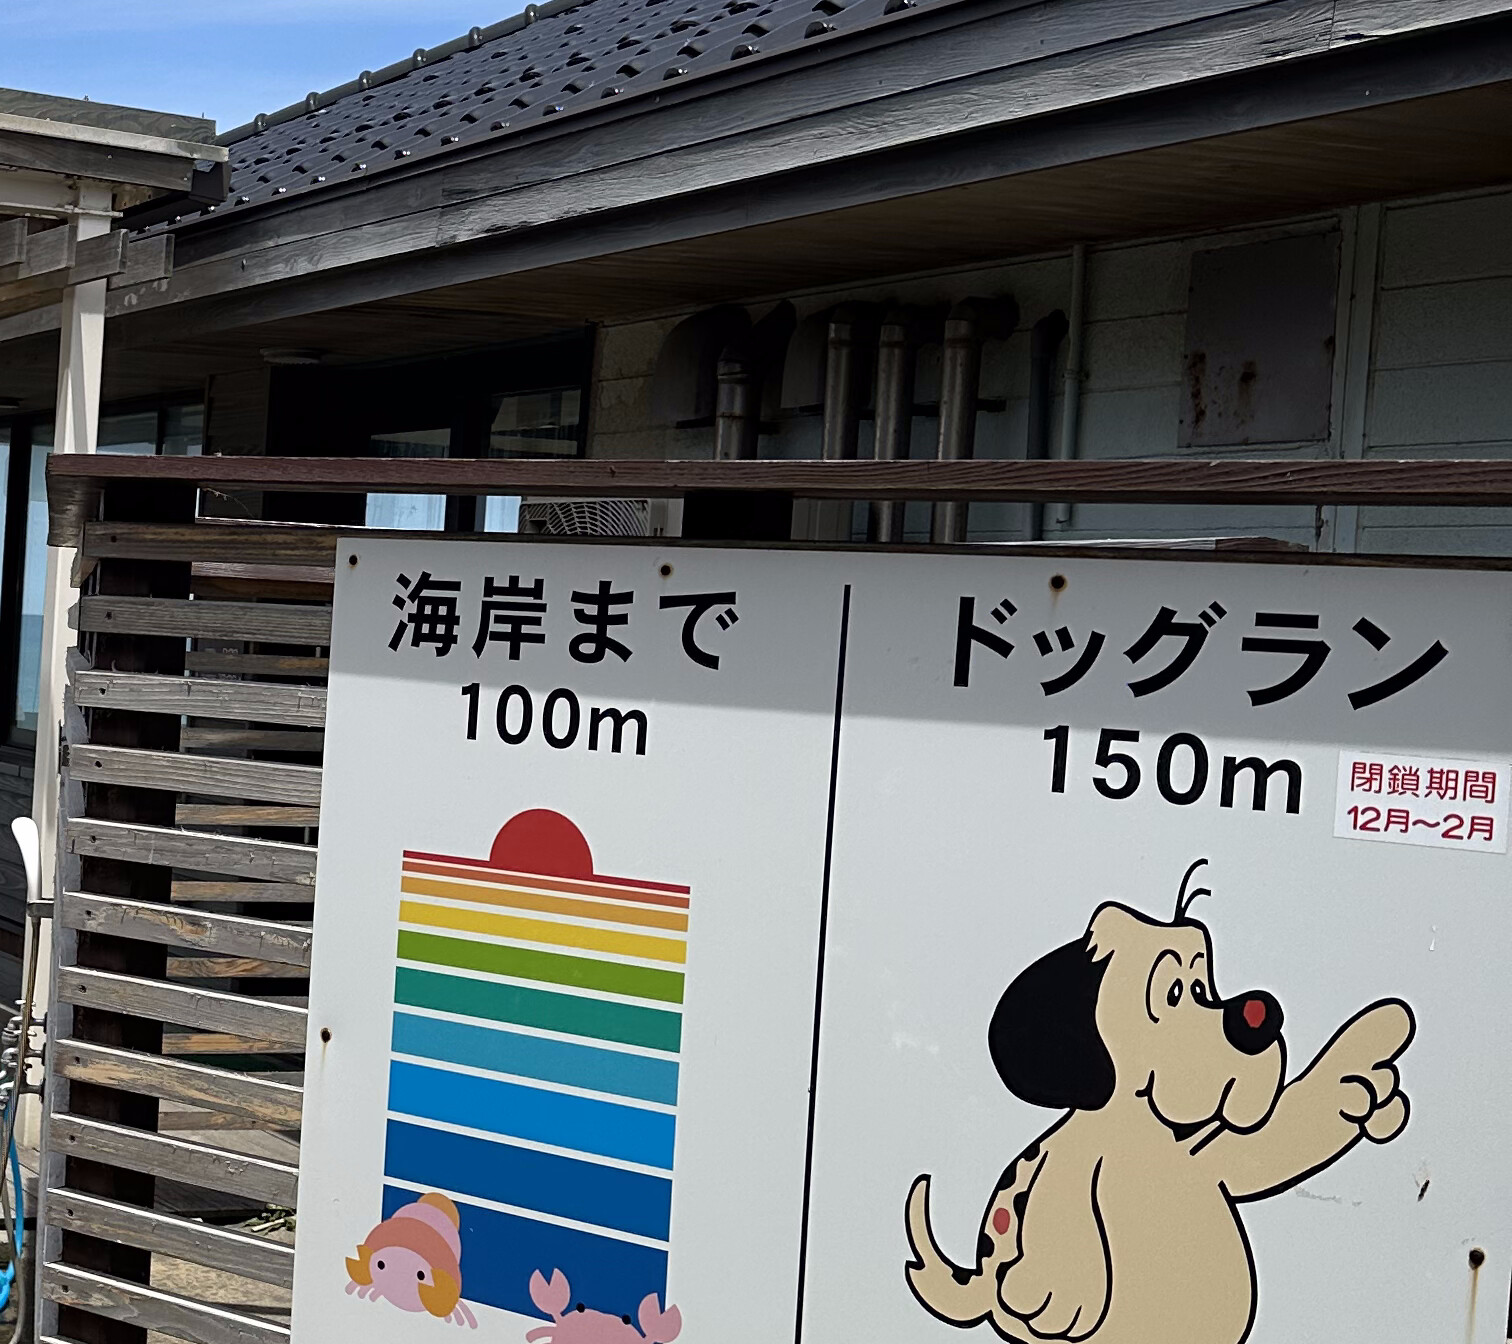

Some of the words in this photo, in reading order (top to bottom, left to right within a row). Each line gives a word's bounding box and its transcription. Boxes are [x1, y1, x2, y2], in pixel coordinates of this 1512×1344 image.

[388, 570, 739, 671] 海岸まで
[952, 596, 1450, 711] ドッグラン
[461, 682, 648, 756] 100m
[1043, 724, 1303, 815] 150m
[1351, 761, 1497, 804] 閉鎖期間
